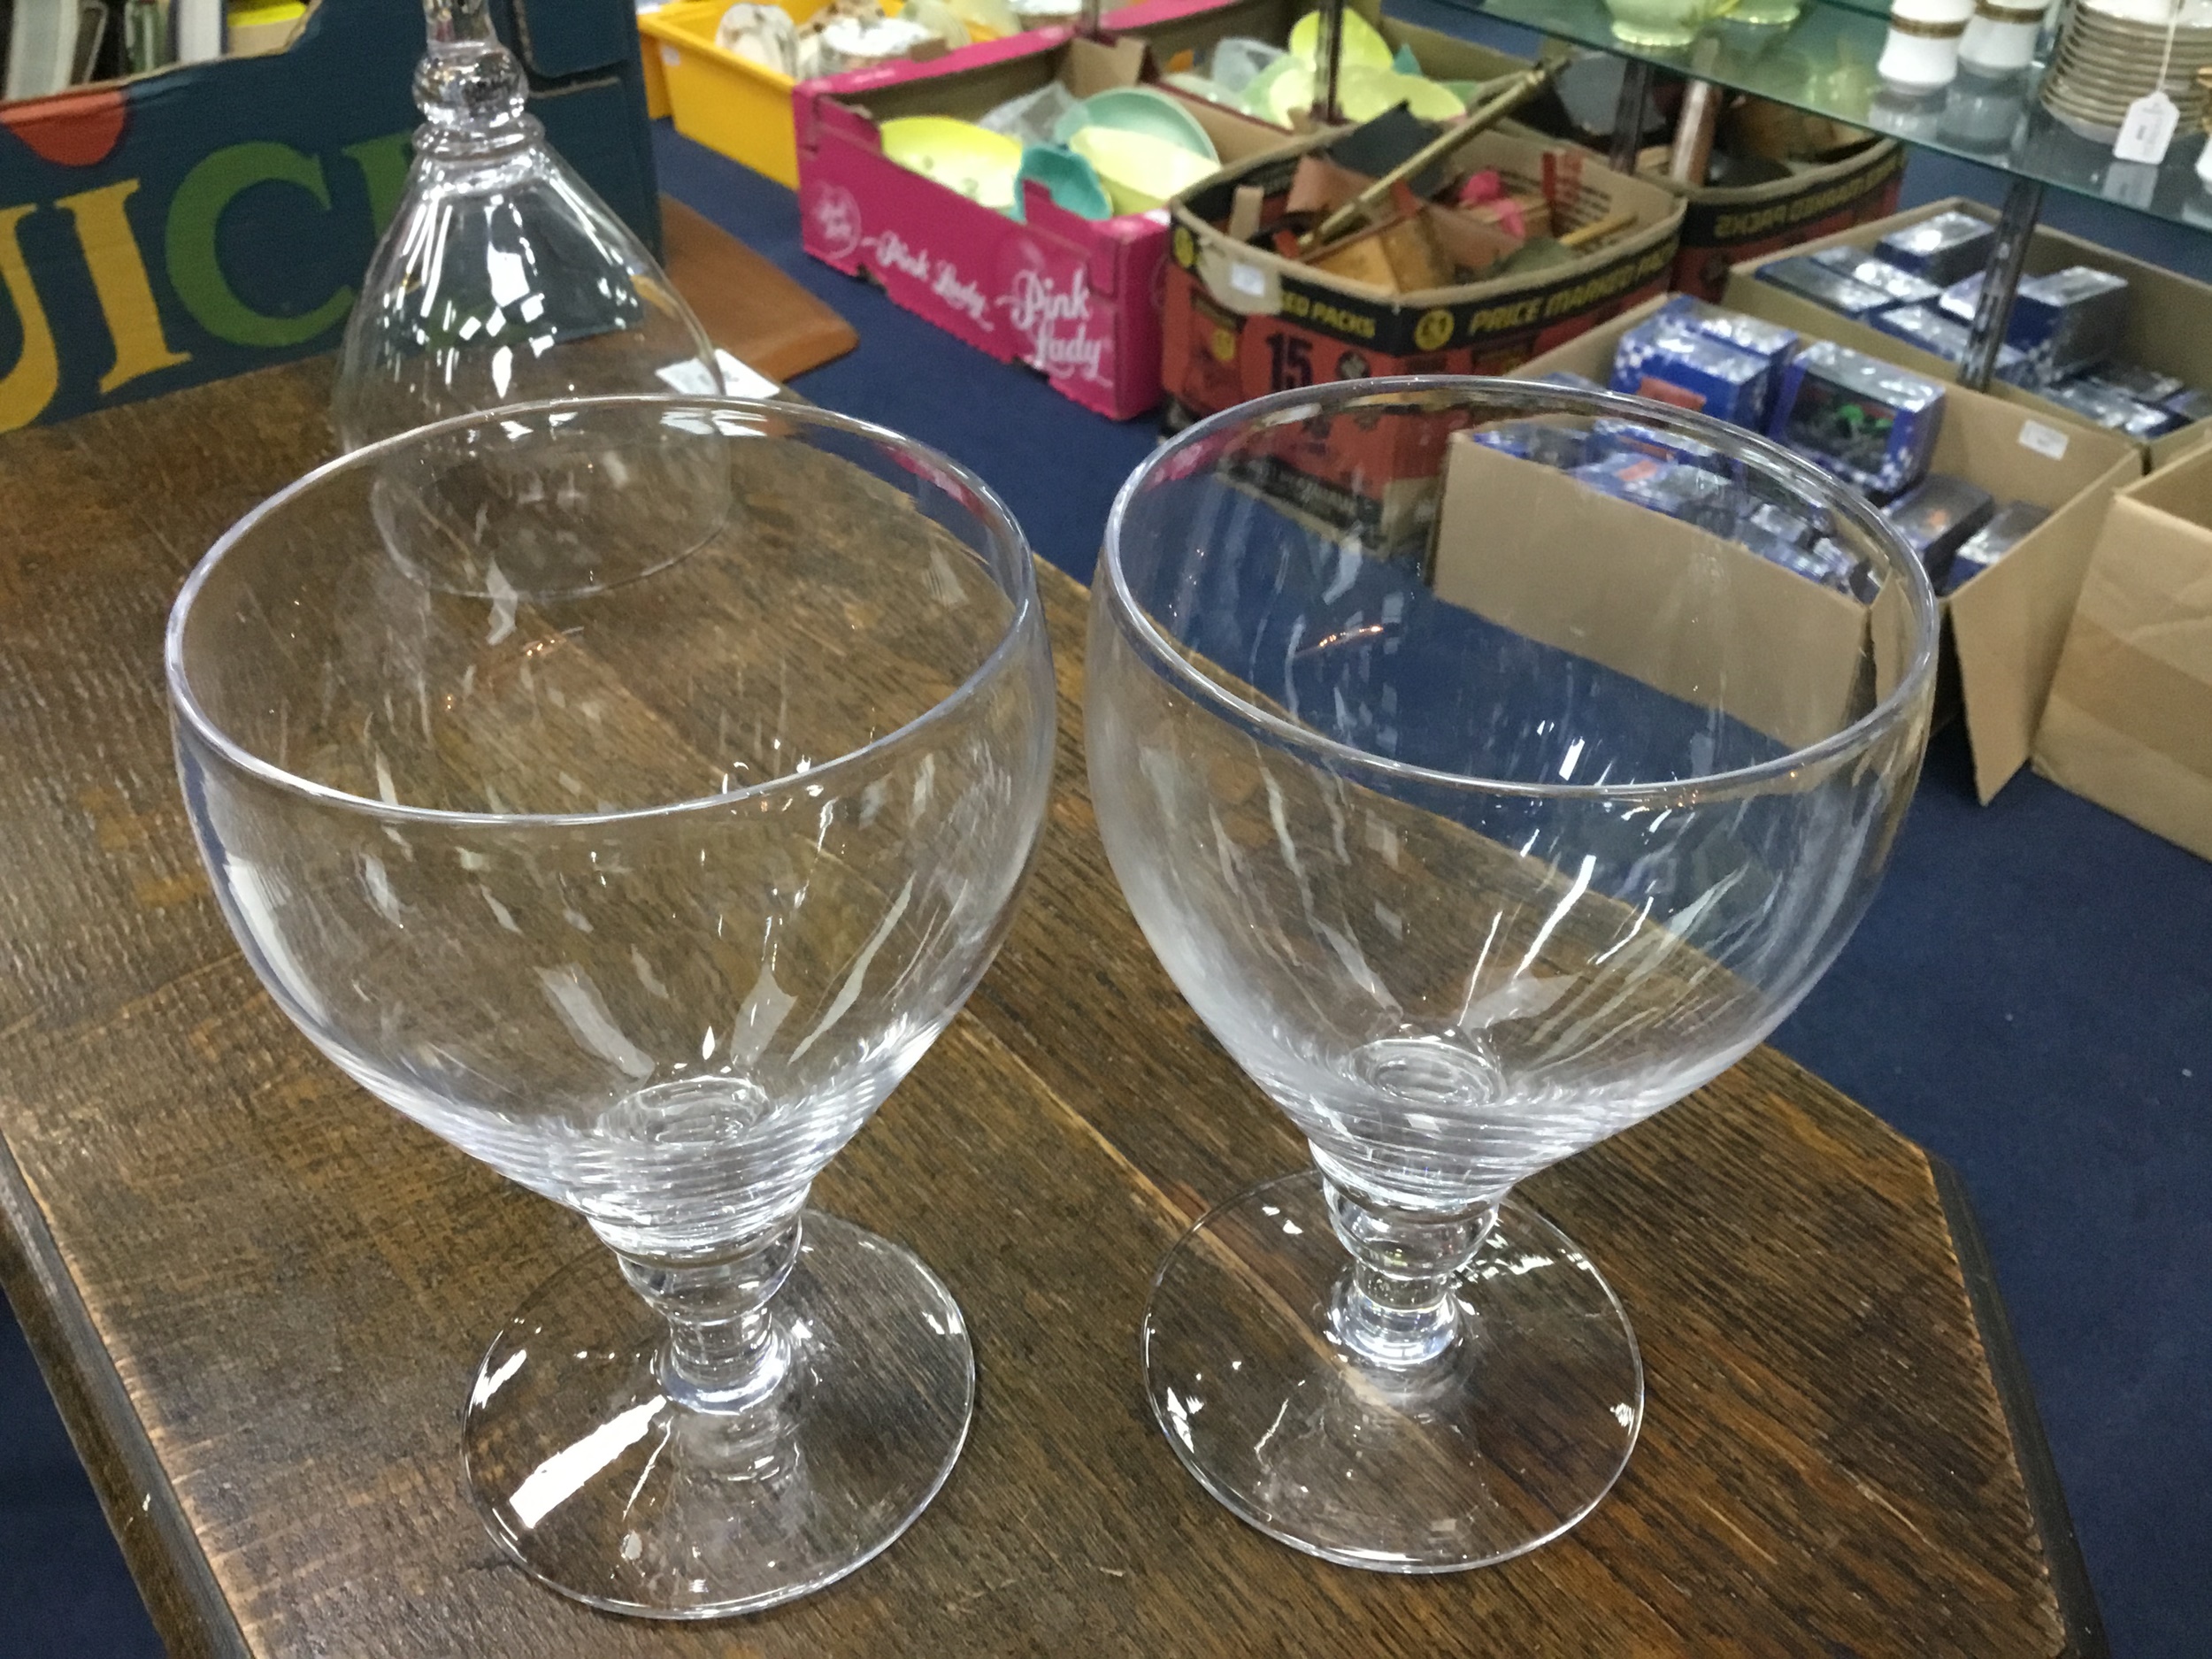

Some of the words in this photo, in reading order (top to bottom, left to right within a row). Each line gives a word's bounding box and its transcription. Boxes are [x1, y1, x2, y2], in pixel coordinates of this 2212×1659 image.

[995, 268, 1093, 331] Pink
[1469, 297, 1545, 337] PRICE
[1031, 325, 1113, 387] Lady
